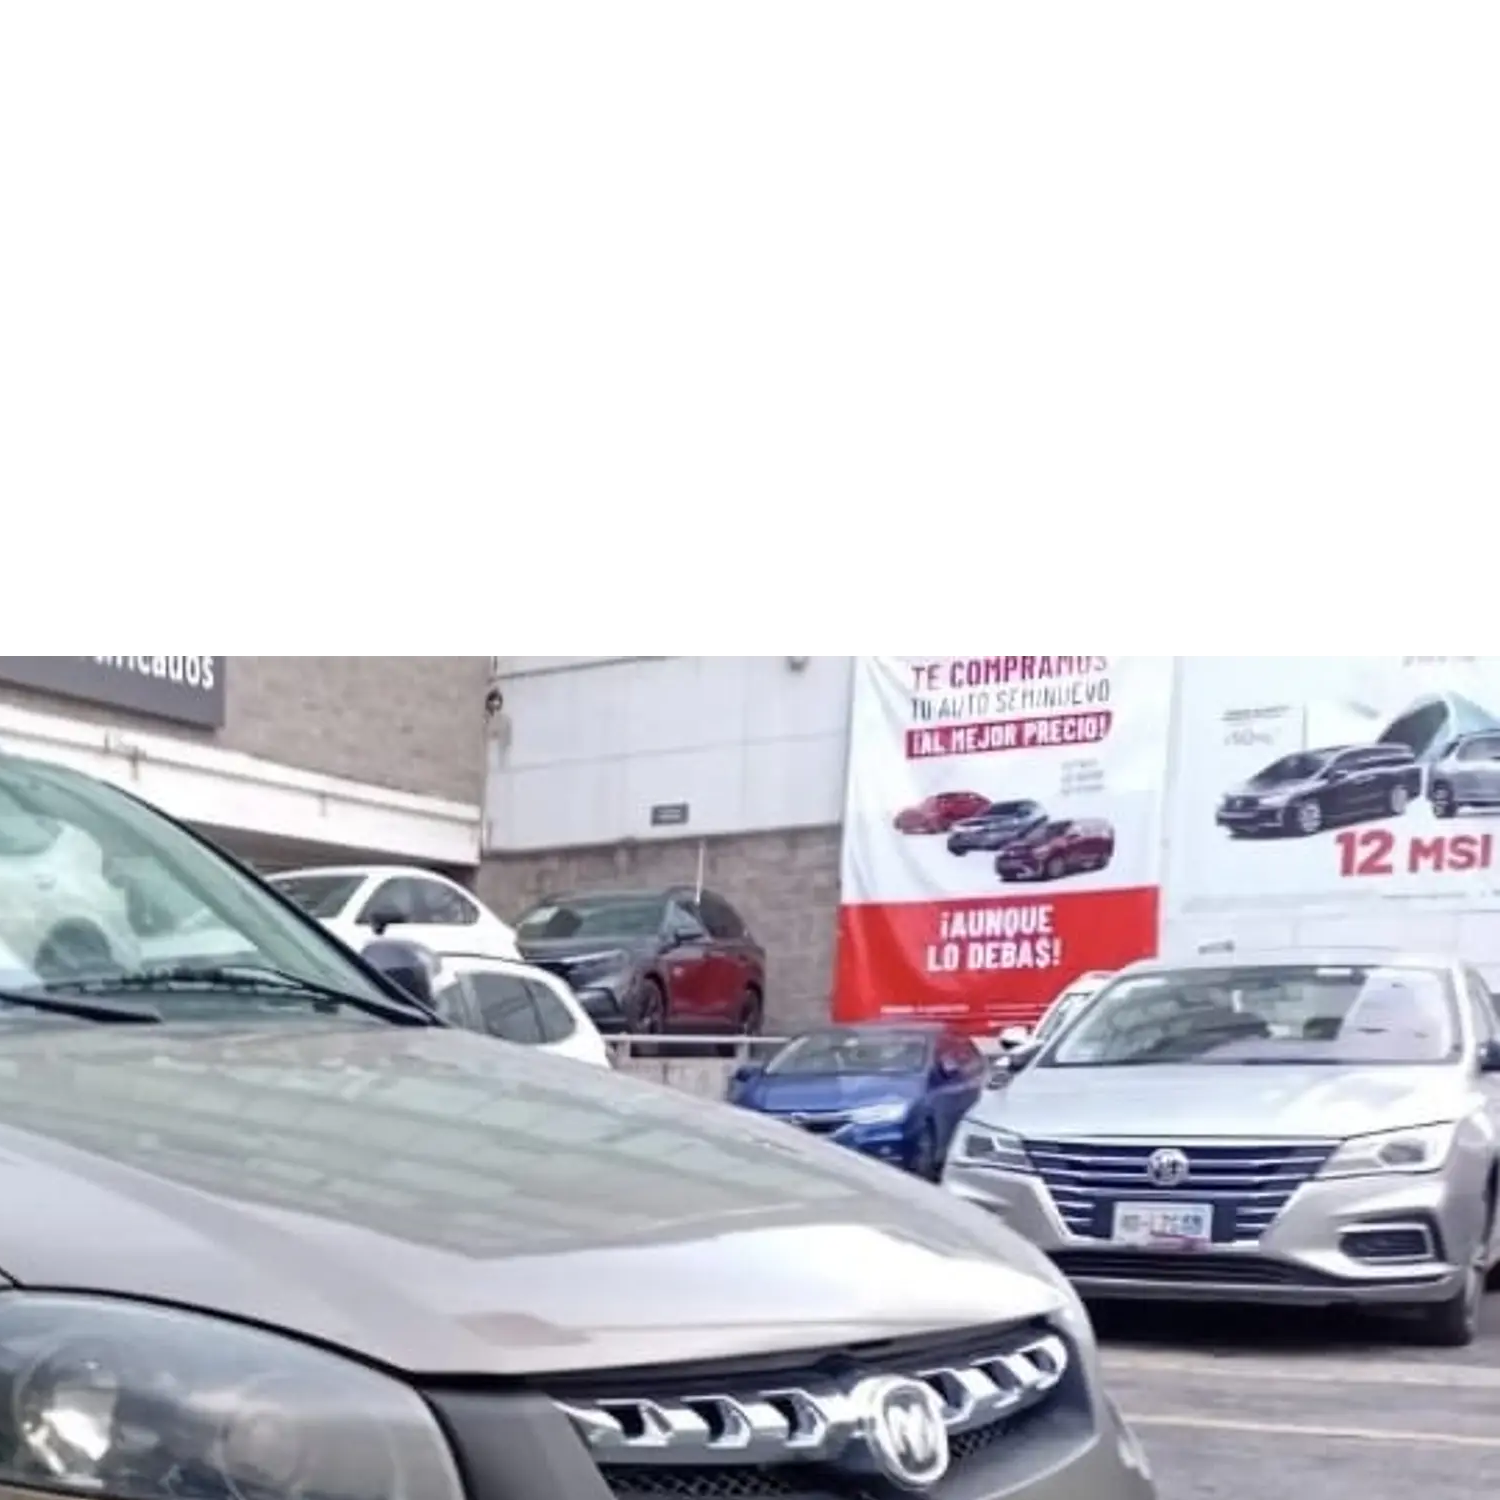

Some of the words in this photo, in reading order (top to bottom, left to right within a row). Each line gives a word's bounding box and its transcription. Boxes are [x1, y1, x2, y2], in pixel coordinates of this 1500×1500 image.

[911, 664, 941, 691] TE
[950, 656, 1108, 688] COMPRAMOS
[912, 697, 931, 720] TU
[938, 691, 989, 719] AUTO
[996, 670, 1110, 714] SEMINUEVO
[913, 731, 946, 756] ¡AL
[952, 723, 1016, 751] MEJOR
[1024, 713, 1106, 746] PRECIO!
[1335, 829, 1395, 877] 12
[1408, 834, 1493, 873] MSI
[940, 904, 1055, 939] ¡AUNQUE
[926, 944, 960, 972] LO
[967, 937, 1063, 970] DEBAS!
